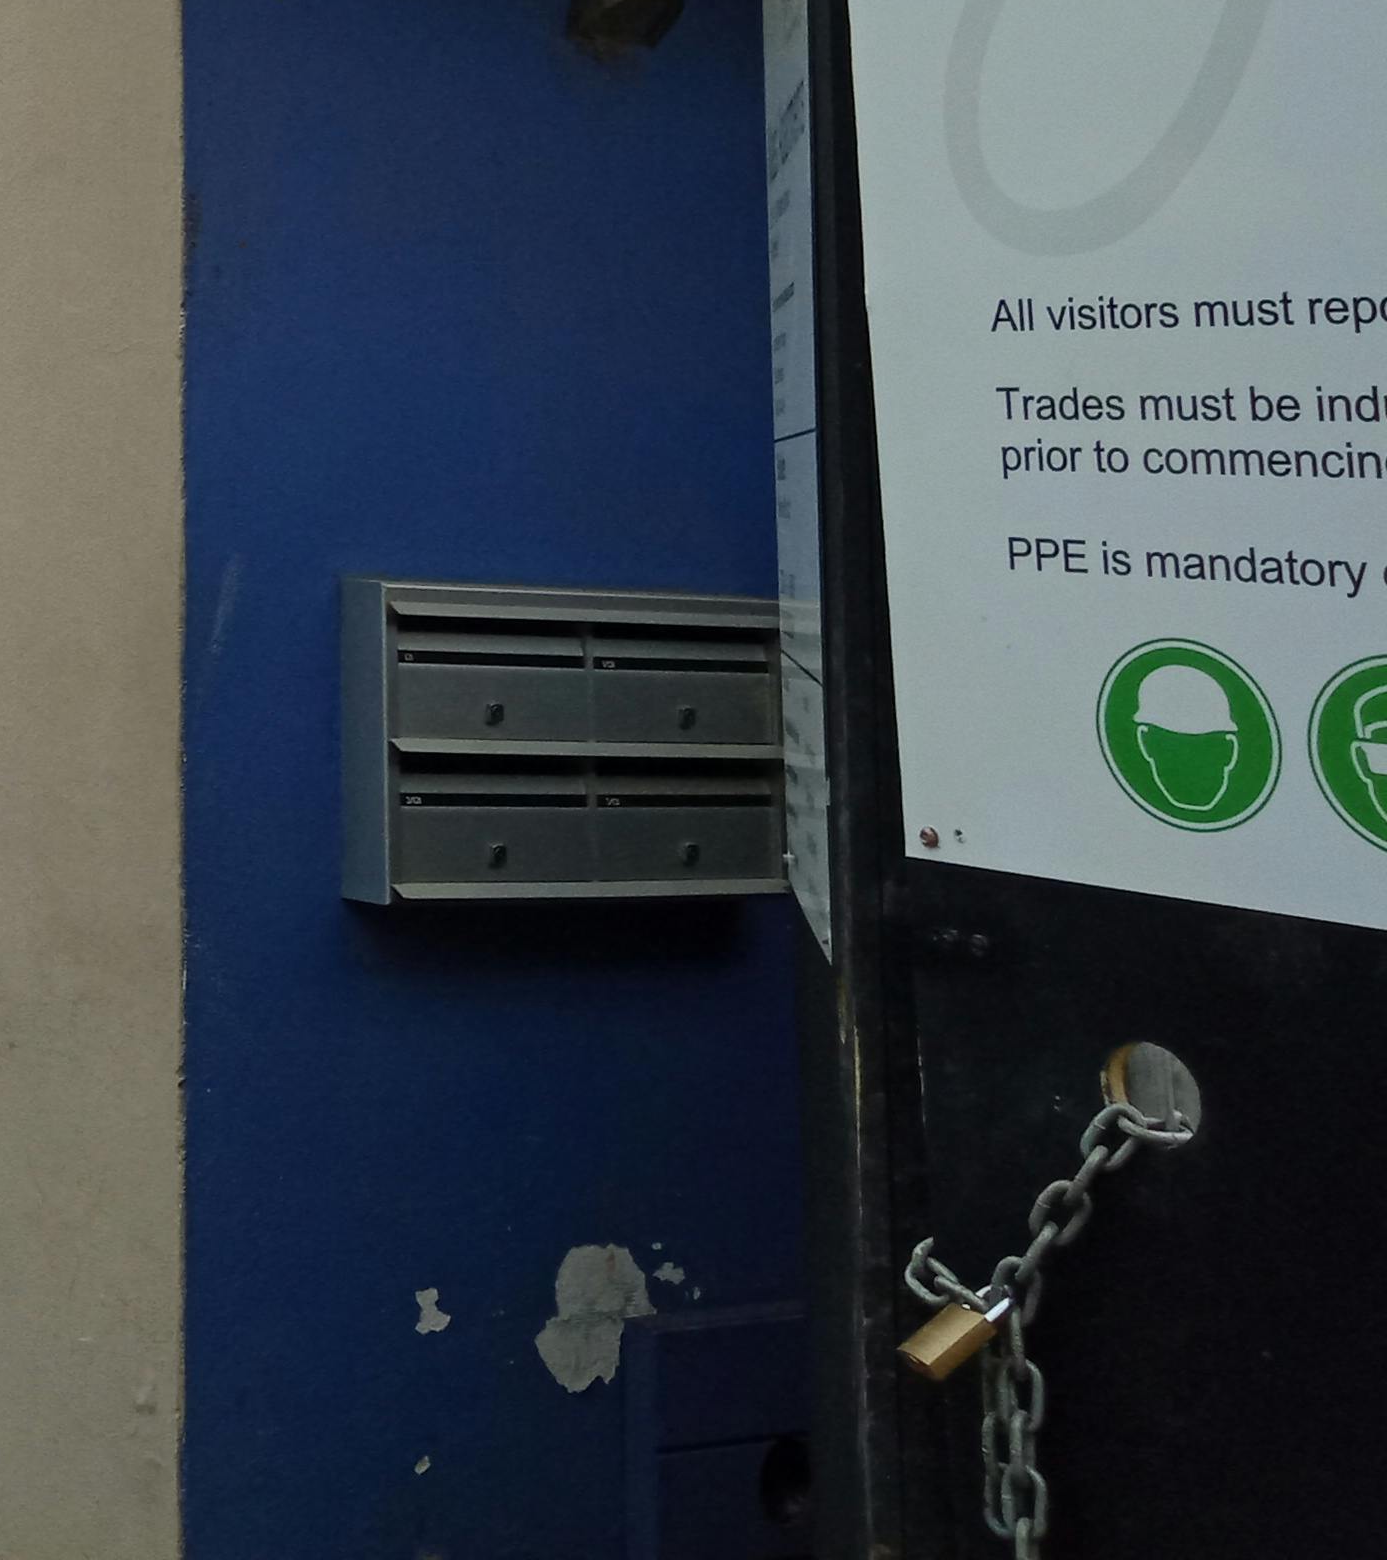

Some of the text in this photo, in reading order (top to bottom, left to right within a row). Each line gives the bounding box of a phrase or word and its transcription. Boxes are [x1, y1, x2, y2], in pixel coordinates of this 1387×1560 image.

[991, 298, 1034, 332] All
[1047, 296, 1179, 331] visitors
[1194, 291, 1295, 328] must
[996, 385, 1387, 423] Trades must be ind
[1001, 438, 1387, 480] prior to commencin
[1007, 536, 1089, 574] PPE
[1101, 541, 1132, 576] is
[1145, 548, 1367, 599] mandatory
